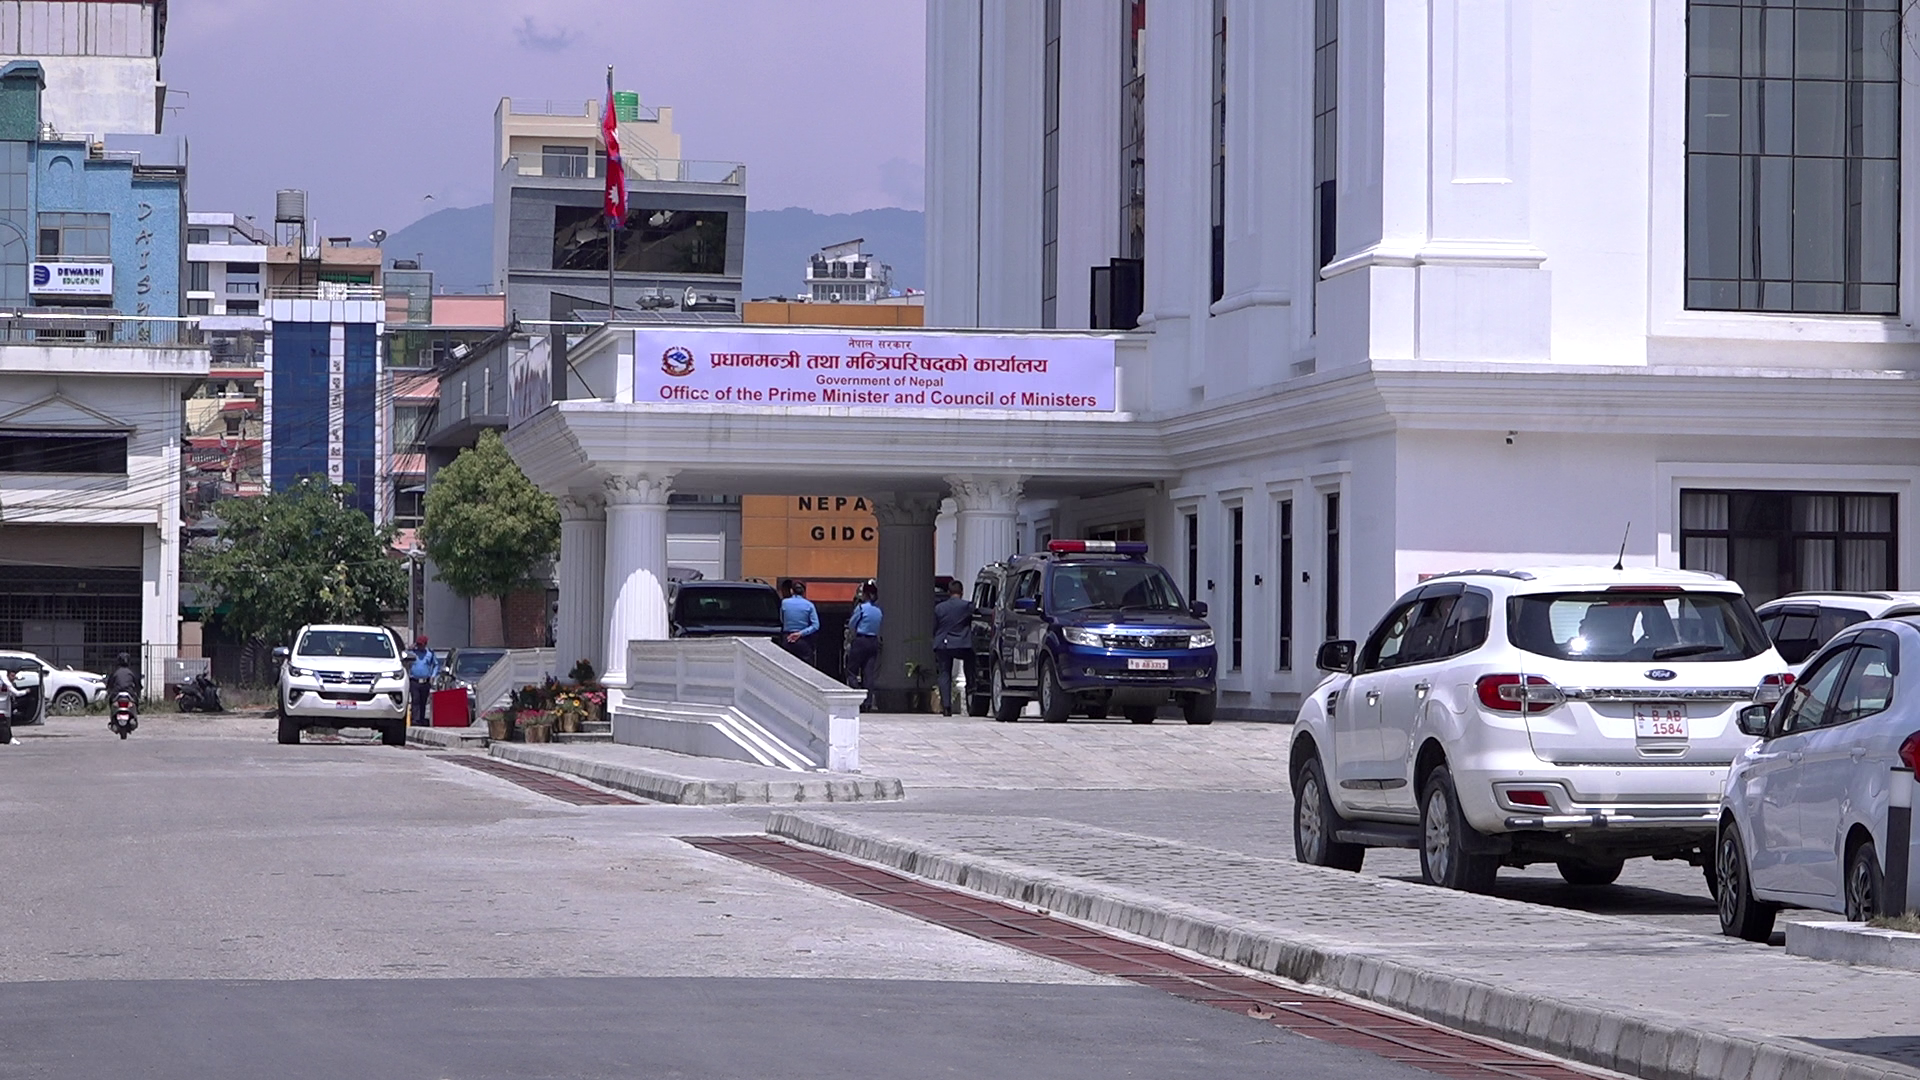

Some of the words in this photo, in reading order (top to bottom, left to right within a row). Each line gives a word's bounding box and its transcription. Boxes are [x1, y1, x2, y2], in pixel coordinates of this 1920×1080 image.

[57, 268, 104, 277] DEWARSHI
[849, 337, 873, 349] नेपाल
[878, 340, 912, 350] सरकार
[710, 350, 801, 370] प्रधानमन्त्री
[806, 354, 840, 370] तथा
[973, 355, 1048, 373] कार्यालय
[816, 374, 890, 386] Government
[894, 376, 905, 387] of
[909, 377, 944, 389] Nepal
[660, 385, 709, 401] Office
[715, 386, 732, 401] of
[736, 387, 762, 402] the
[768, 388, 817, 402] Prime
[822, 388, 889, 404] Minister
[894, 390, 925, 404] and
[931, 391, 994, 406] Council
[1000, 392, 1016, 406] of
[1021, 392, 1097, 407] Ministers
[799, 496, 867, 511] NEPA
[811, 526, 874, 541] GIDC
[1651, 670, 1671, 678] Ford
[1652, 710, 1660, 722] B
[1666, 710, 1682, 722] AB
[1653, 723, 1683, 735] 1584
